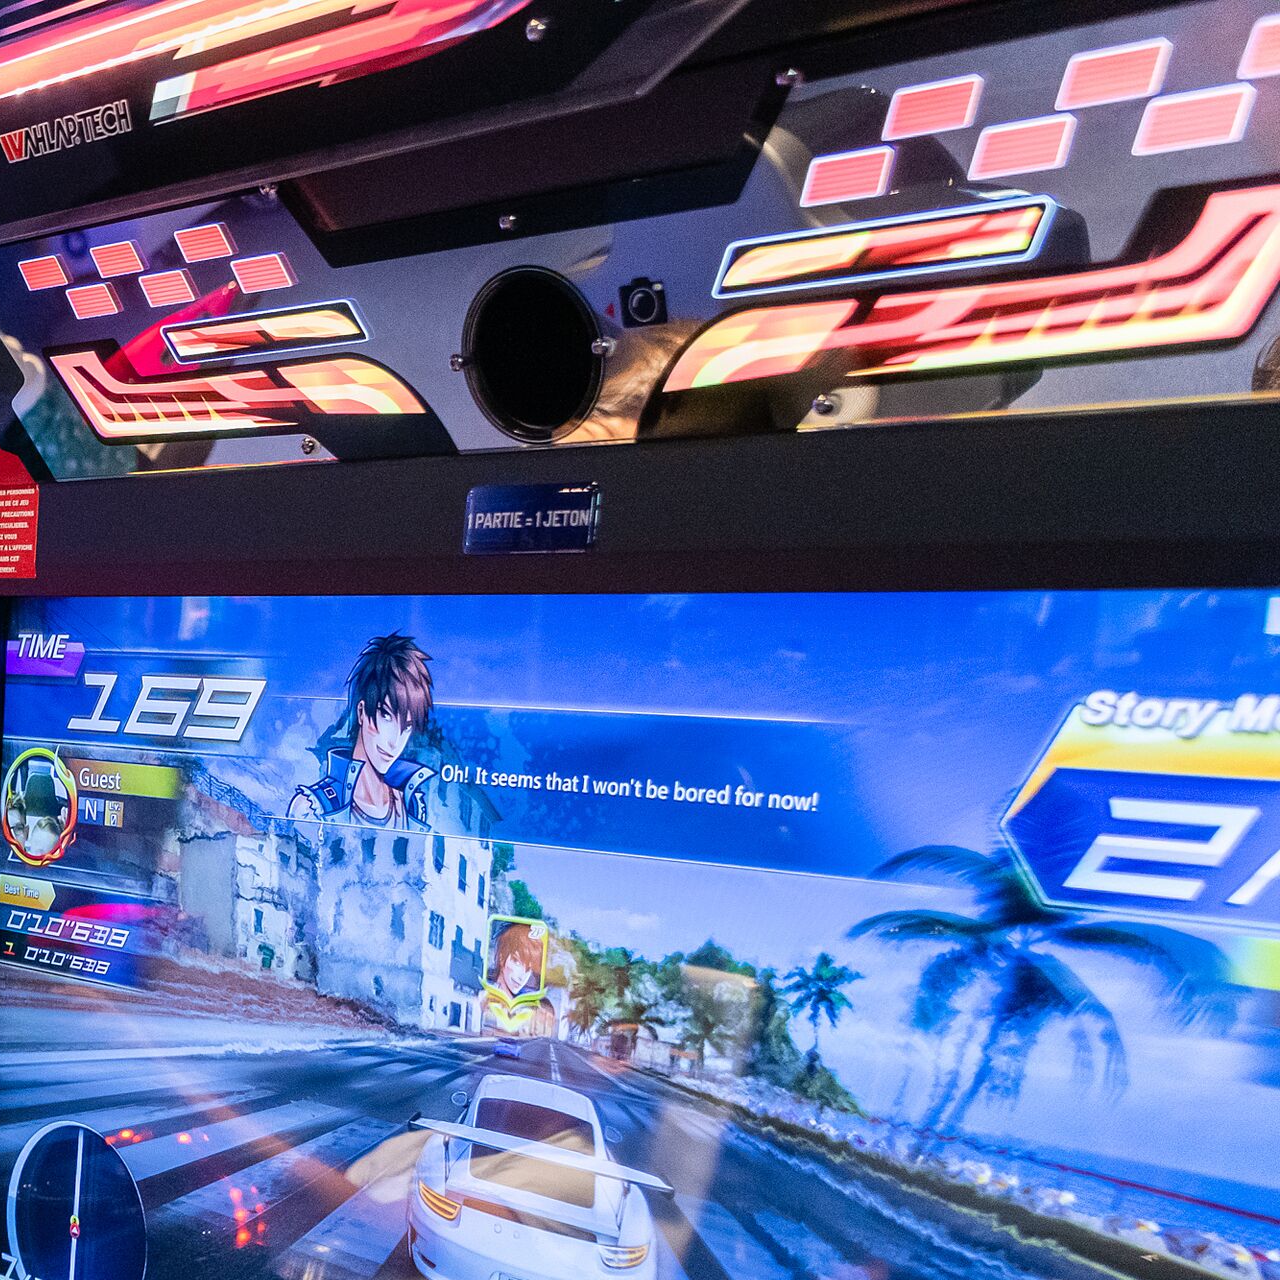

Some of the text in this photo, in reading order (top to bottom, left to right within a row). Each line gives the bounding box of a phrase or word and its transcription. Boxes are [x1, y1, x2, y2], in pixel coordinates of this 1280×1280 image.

[474, 511, 524, 529] PARTIE
[525, 517, 533, 526] =
[535, 511, 542, 528] 1
[542, 509, 591, 528] JETON
[17, 633, 70, 660] TIME
[66, 672, 267, 742] 169
[1079, 689, 1280, 741] Story M
[79, 767, 122, 790] Guest
[440, 764, 820, 812] Oh! It seems that I won't be bored for now!
[84, 800, 97, 821] N
[4, 883, 40, 900] Best Time
[3, 941, 16, 956] 1
